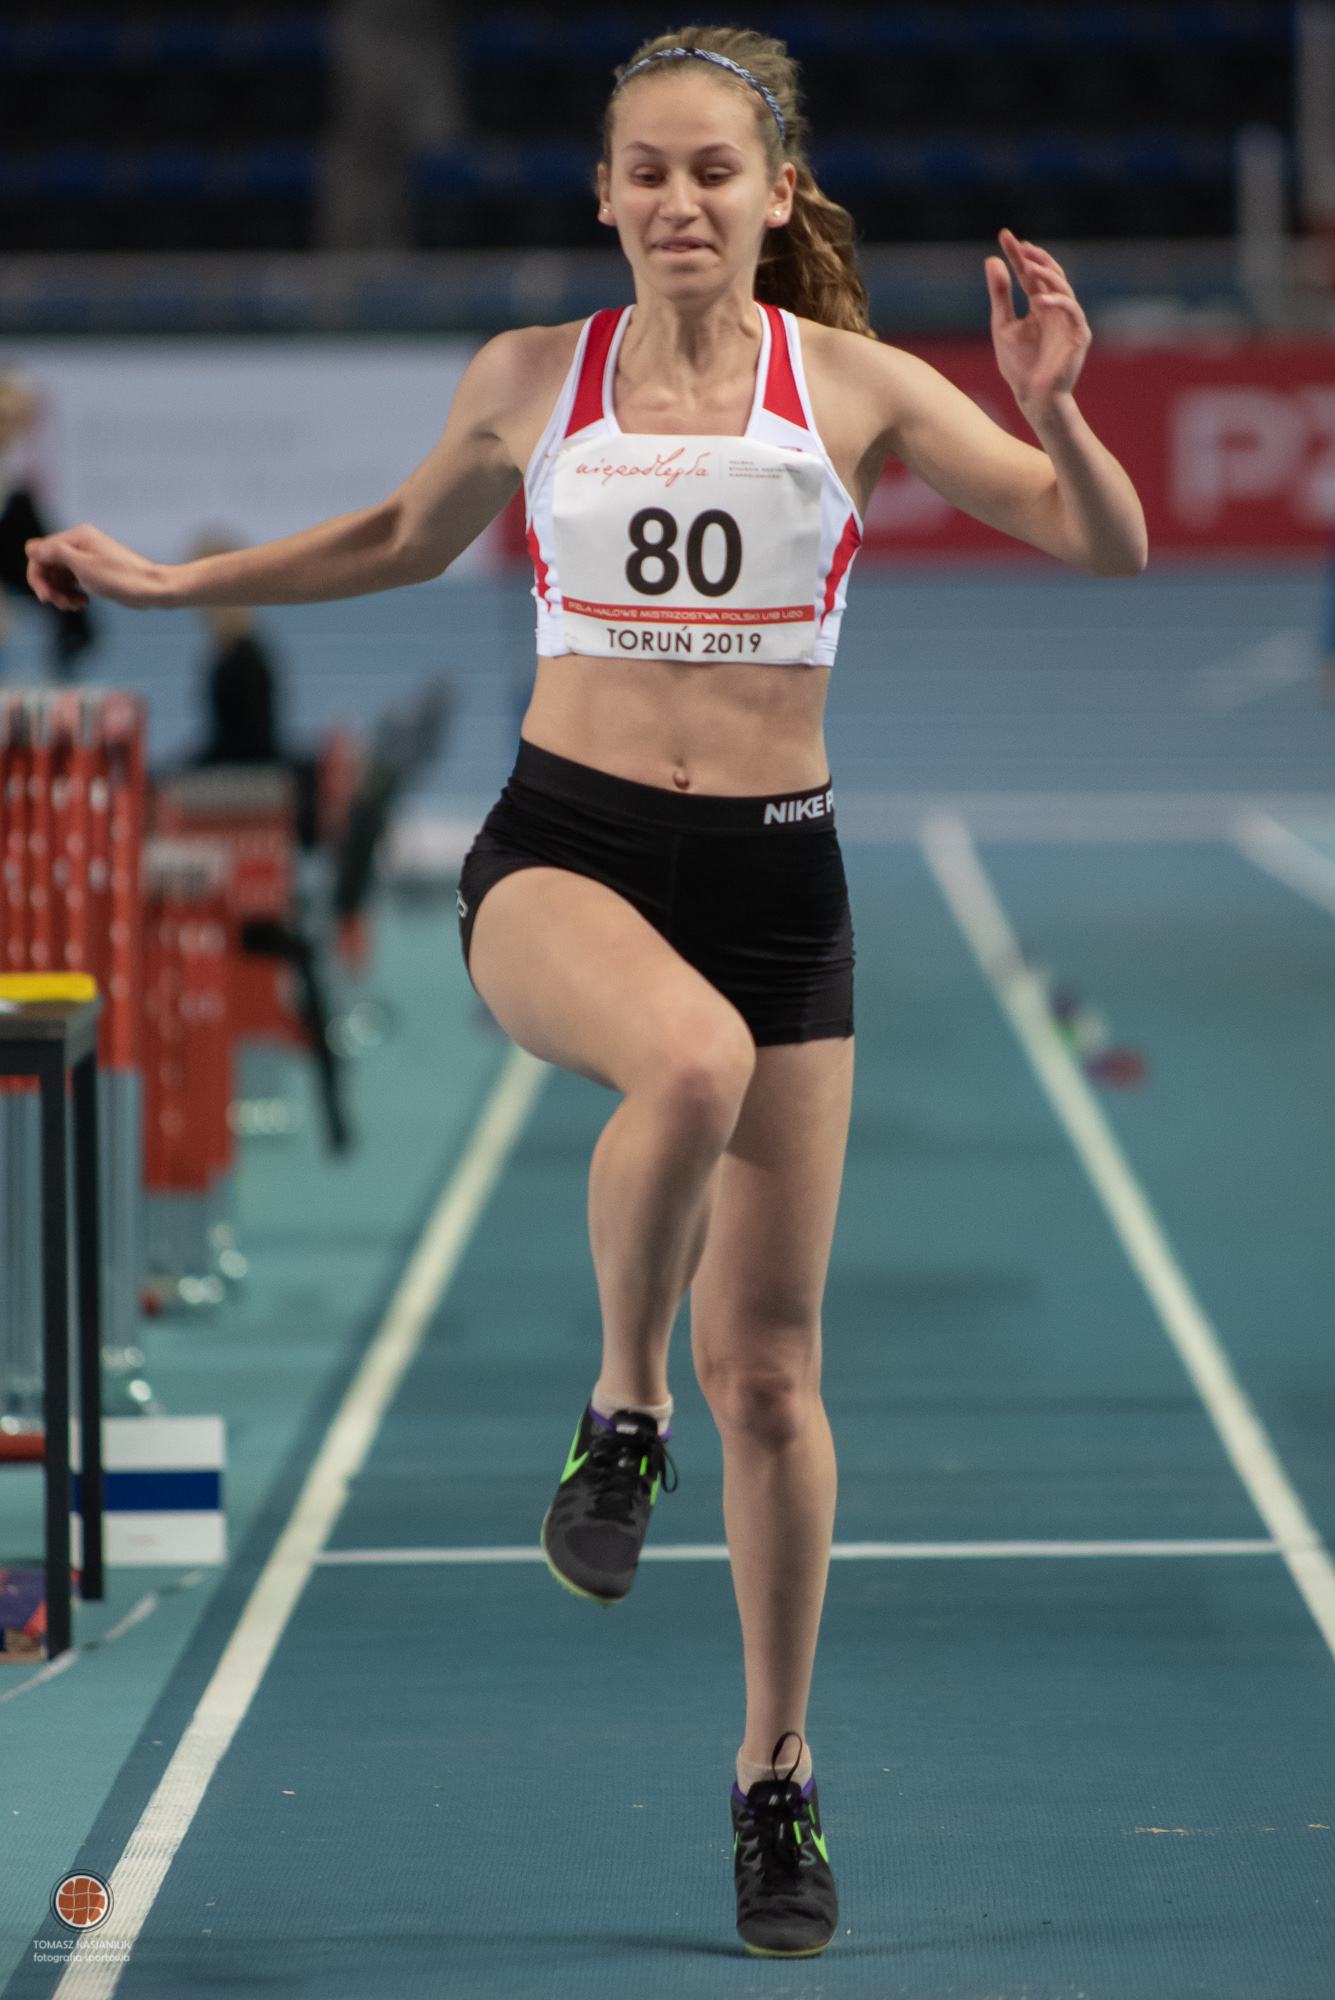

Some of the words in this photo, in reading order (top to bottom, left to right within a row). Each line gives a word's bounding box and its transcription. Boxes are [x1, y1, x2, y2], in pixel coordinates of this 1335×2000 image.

[625, 506, 742, 598] 80
[593, 606, 638, 619] HALOWE
[640, 609, 720, 621] MISTRZOSTWA
[721, 611, 760, 621] POLSKI
[781, 609, 804, 619] U20
[607, 625, 691, 653] TORUŃ
[702, 632, 761, 654] 2019
[763, 794, 825, 825] NIKE
